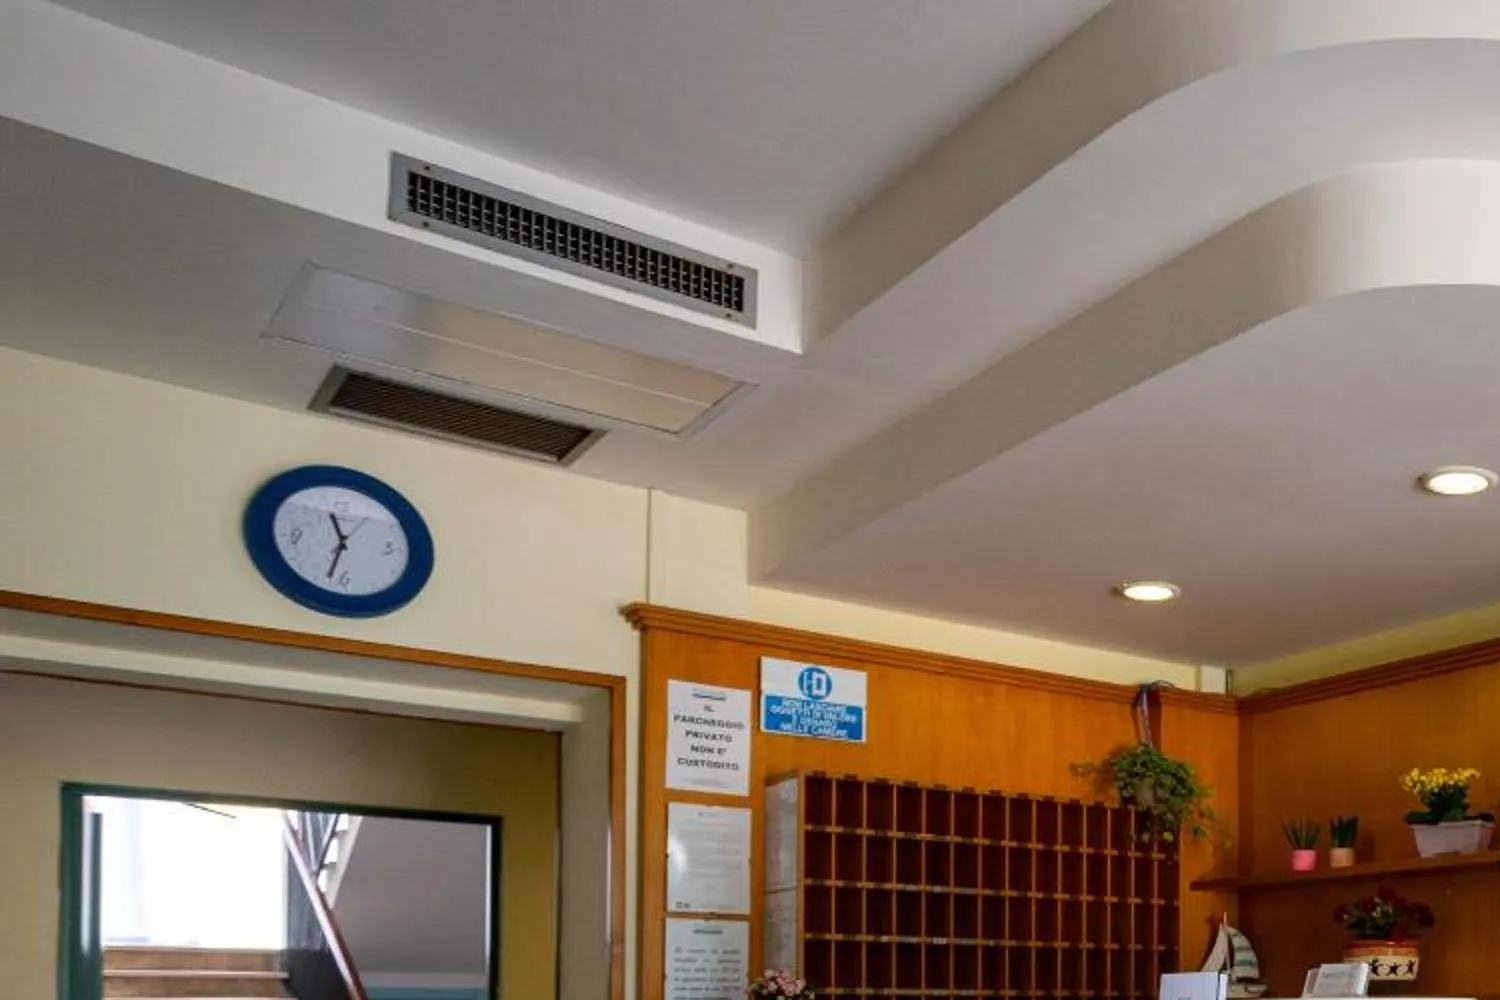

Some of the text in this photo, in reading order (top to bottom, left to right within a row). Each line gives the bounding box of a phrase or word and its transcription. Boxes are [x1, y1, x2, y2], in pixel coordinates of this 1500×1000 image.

[673, 713, 745, 731] PARCHEGGIO
[685, 729, 733, 743] PRIVATO
[690, 744, 715, 755] NON
[677, 757, 740, 771] CUSTODITO
